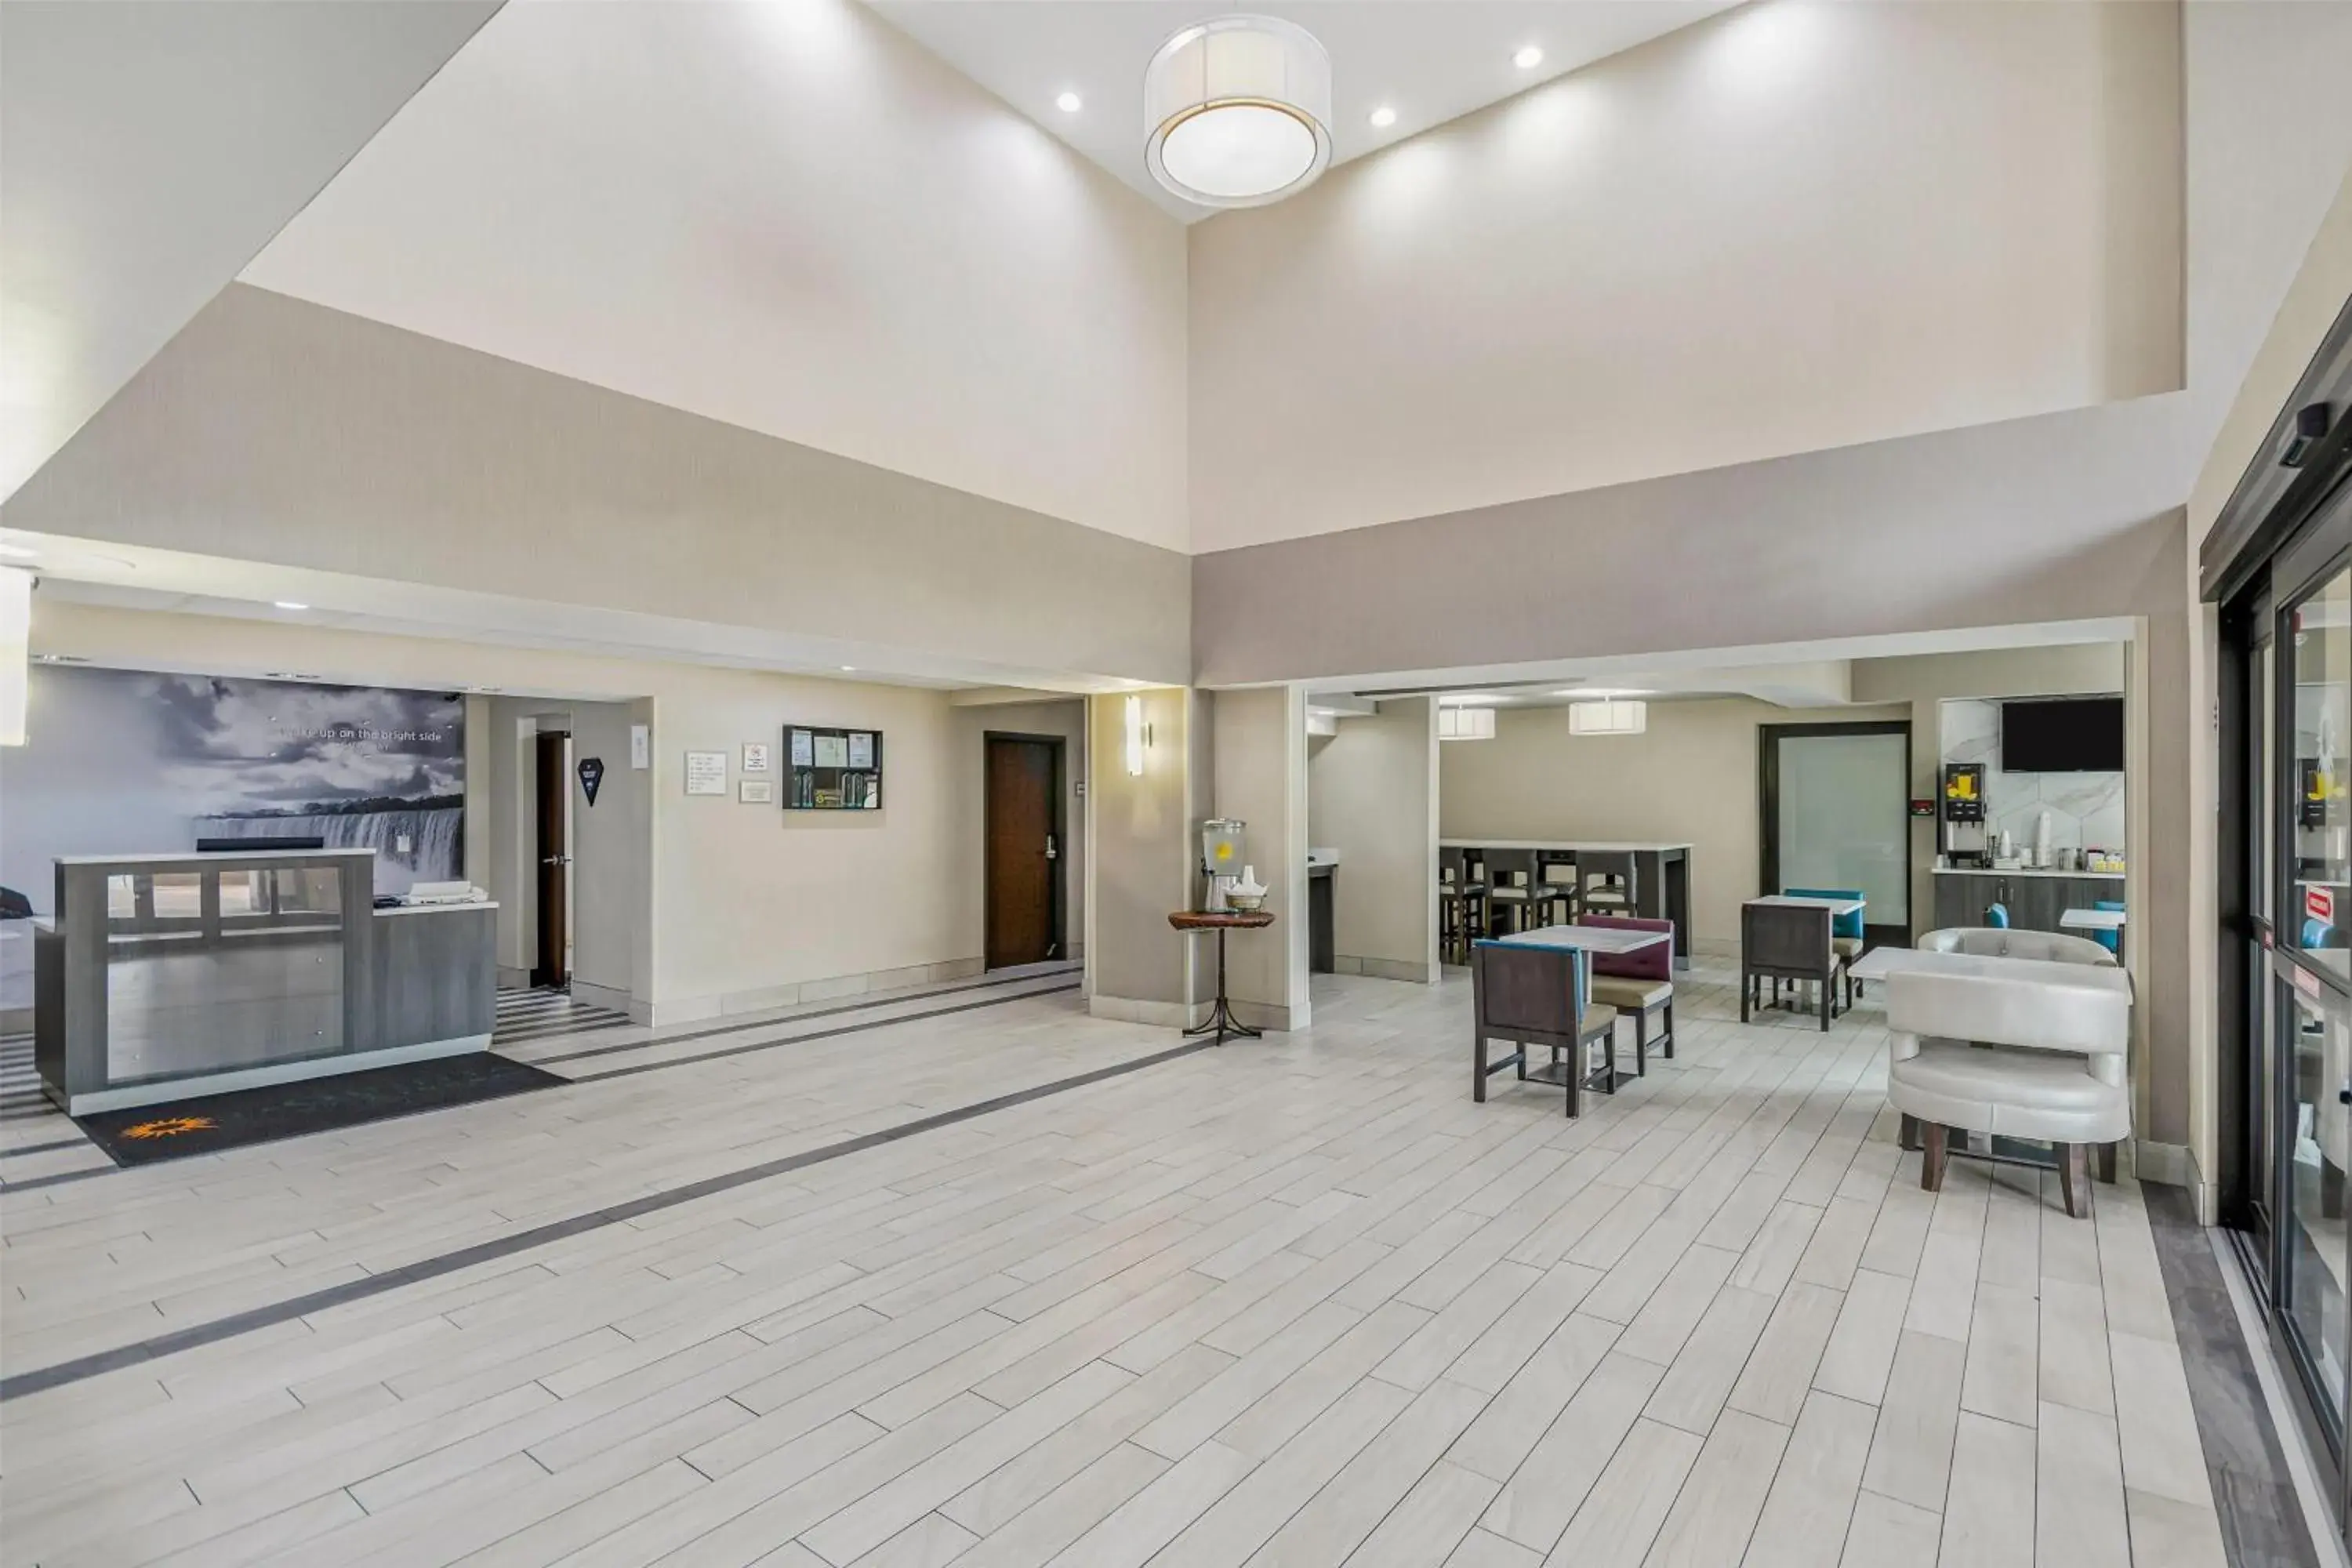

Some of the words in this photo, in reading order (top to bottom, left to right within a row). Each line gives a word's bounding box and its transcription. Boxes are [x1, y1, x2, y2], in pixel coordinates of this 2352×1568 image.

[318, 728, 335, 740] up
[339, 729, 354, 739] on
[358, 728, 379, 739] the
[380, 729, 416, 743] bright
[418, 730, 441, 742] side
